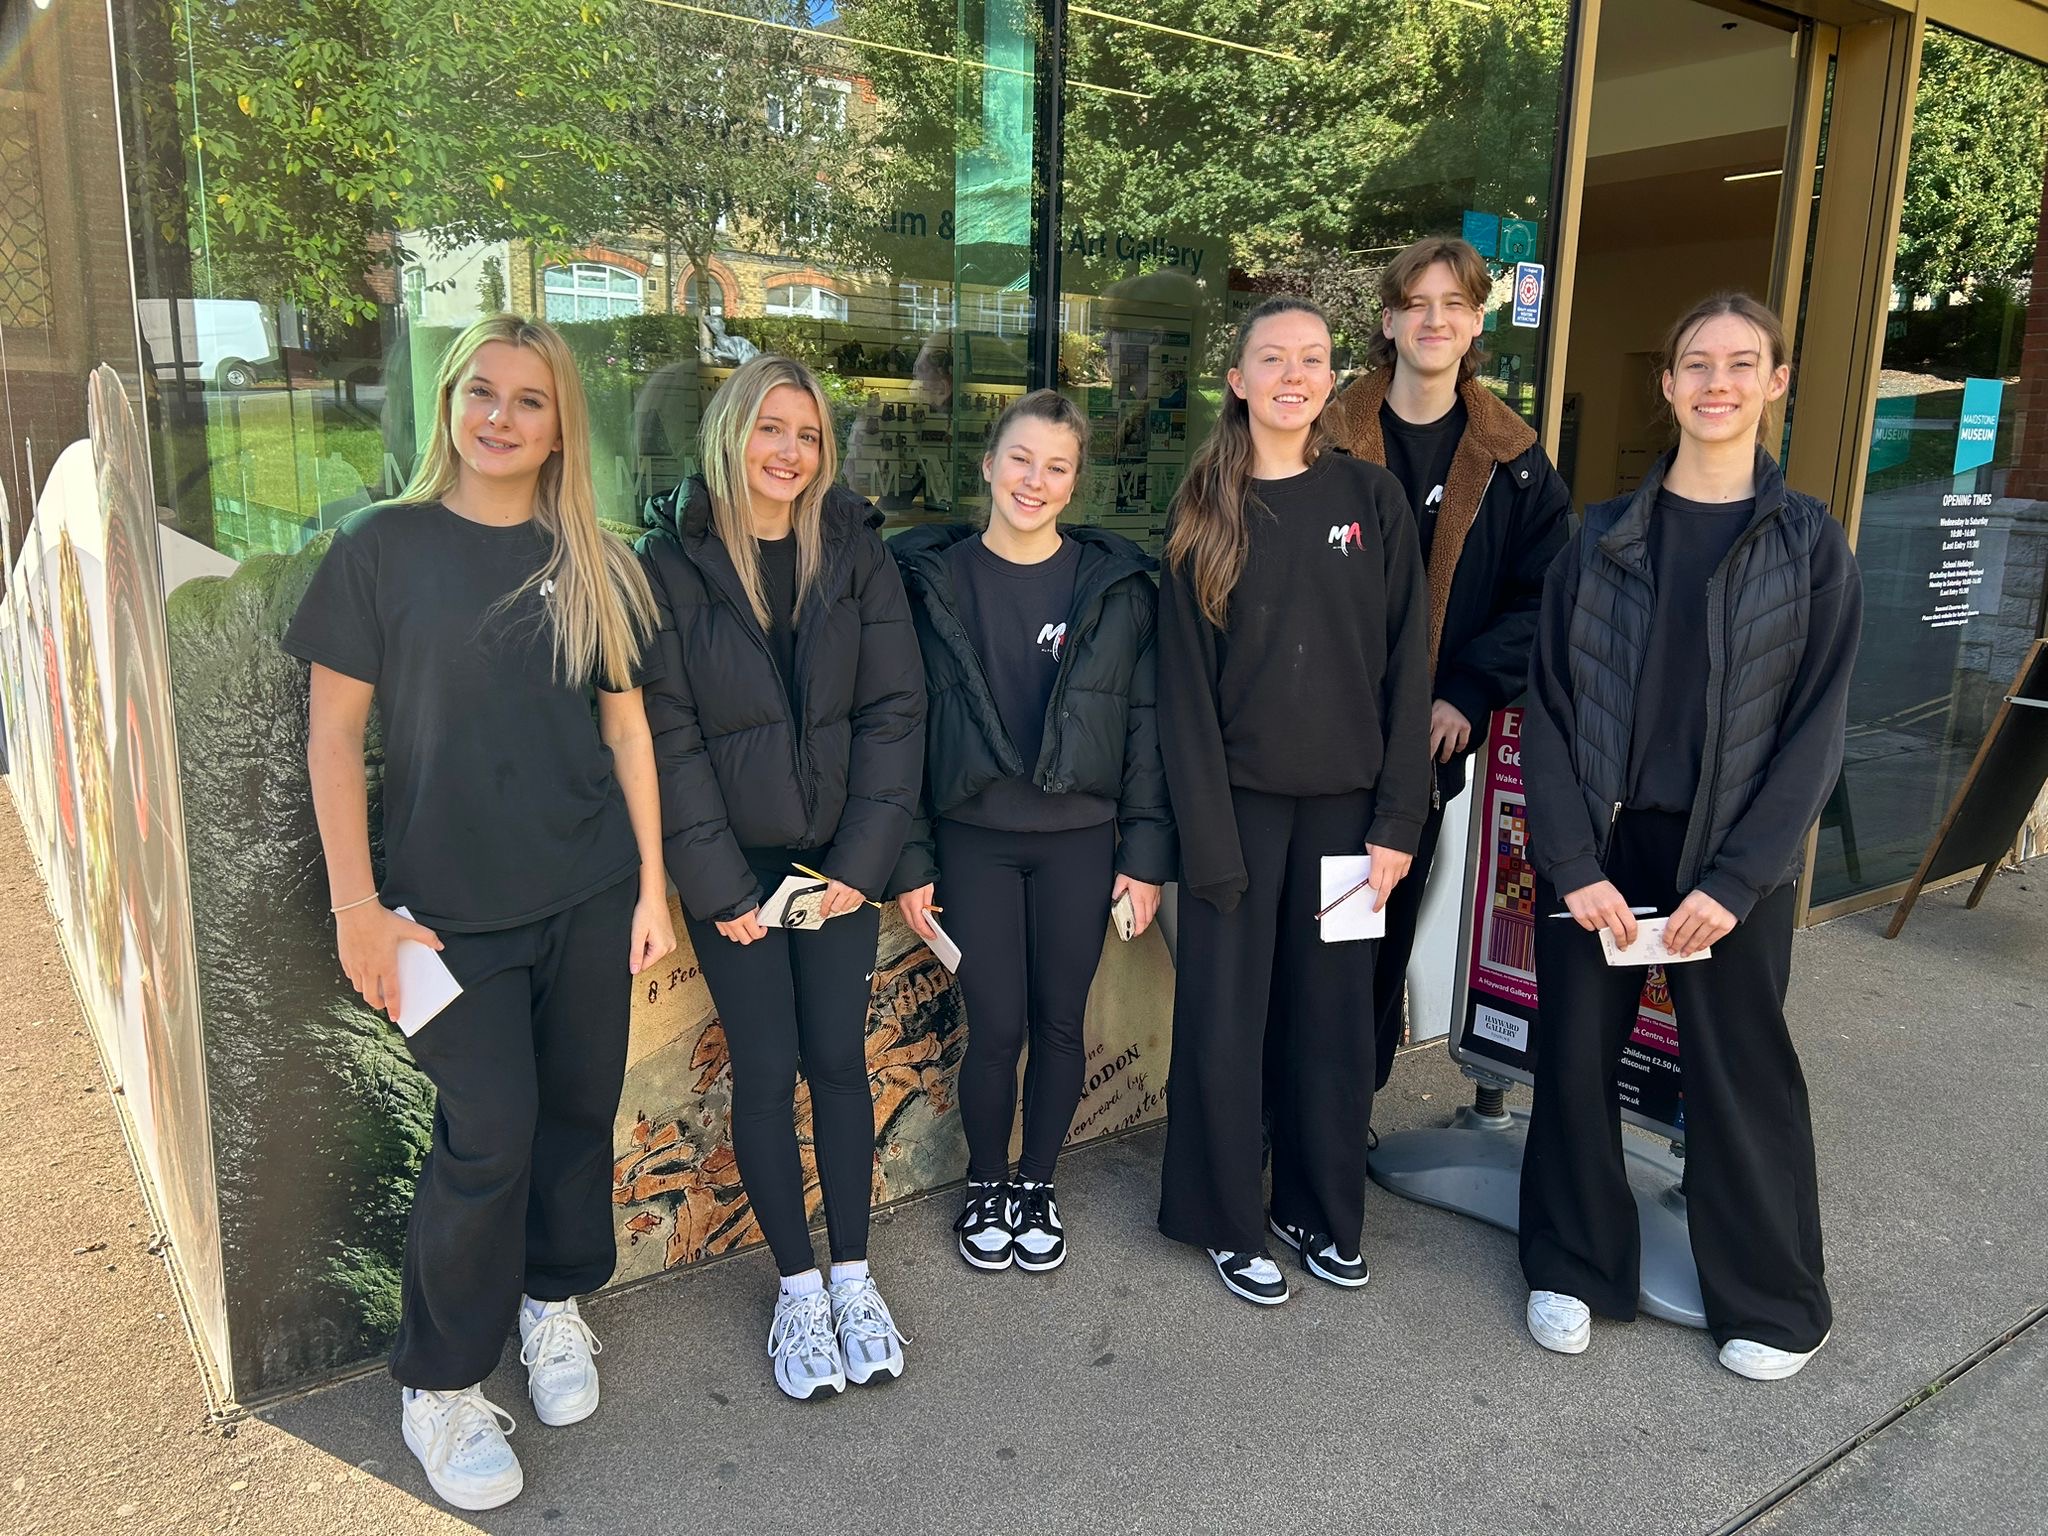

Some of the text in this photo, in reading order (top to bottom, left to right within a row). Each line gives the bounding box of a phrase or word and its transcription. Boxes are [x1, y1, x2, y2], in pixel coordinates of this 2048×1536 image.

[1068, 226, 1107, 258] Art
[1115, 231, 1203, 275] Gallery
[1963, 414, 1996, 425] MAIDSTONE
[1875, 429, 1910, 440] MUSEUM
[1961, 428, 1994, 441] MUSEUM
[1942, 494, 1992, 506] OPENING TIMES
[1940, 518, 1964, 527] Wednesday
[1970, 517, 1989, 526] Saturday
[1502, 711, 1523, 738] E
[1495, 772, 1518, 785] Wake
[1478, 976, 1484, 984] A
[1484, 977, 1509, 992] Hayward
[1509, 987, 1532, 1000] Gallery
[1484, 1014, 1519, 1032] HAYWARD
[1485, 1022, 1516, 1038] GALLERY
[1641, 1028, 1665, 1043] Centre,
[1666, 1036, 1679, 1047] Lon
[1620, 1057, 1650, 1073] discount
[1622, 1046, 1651, 1062] Children
[1652, 1057, 1672, 1070] £2.50
